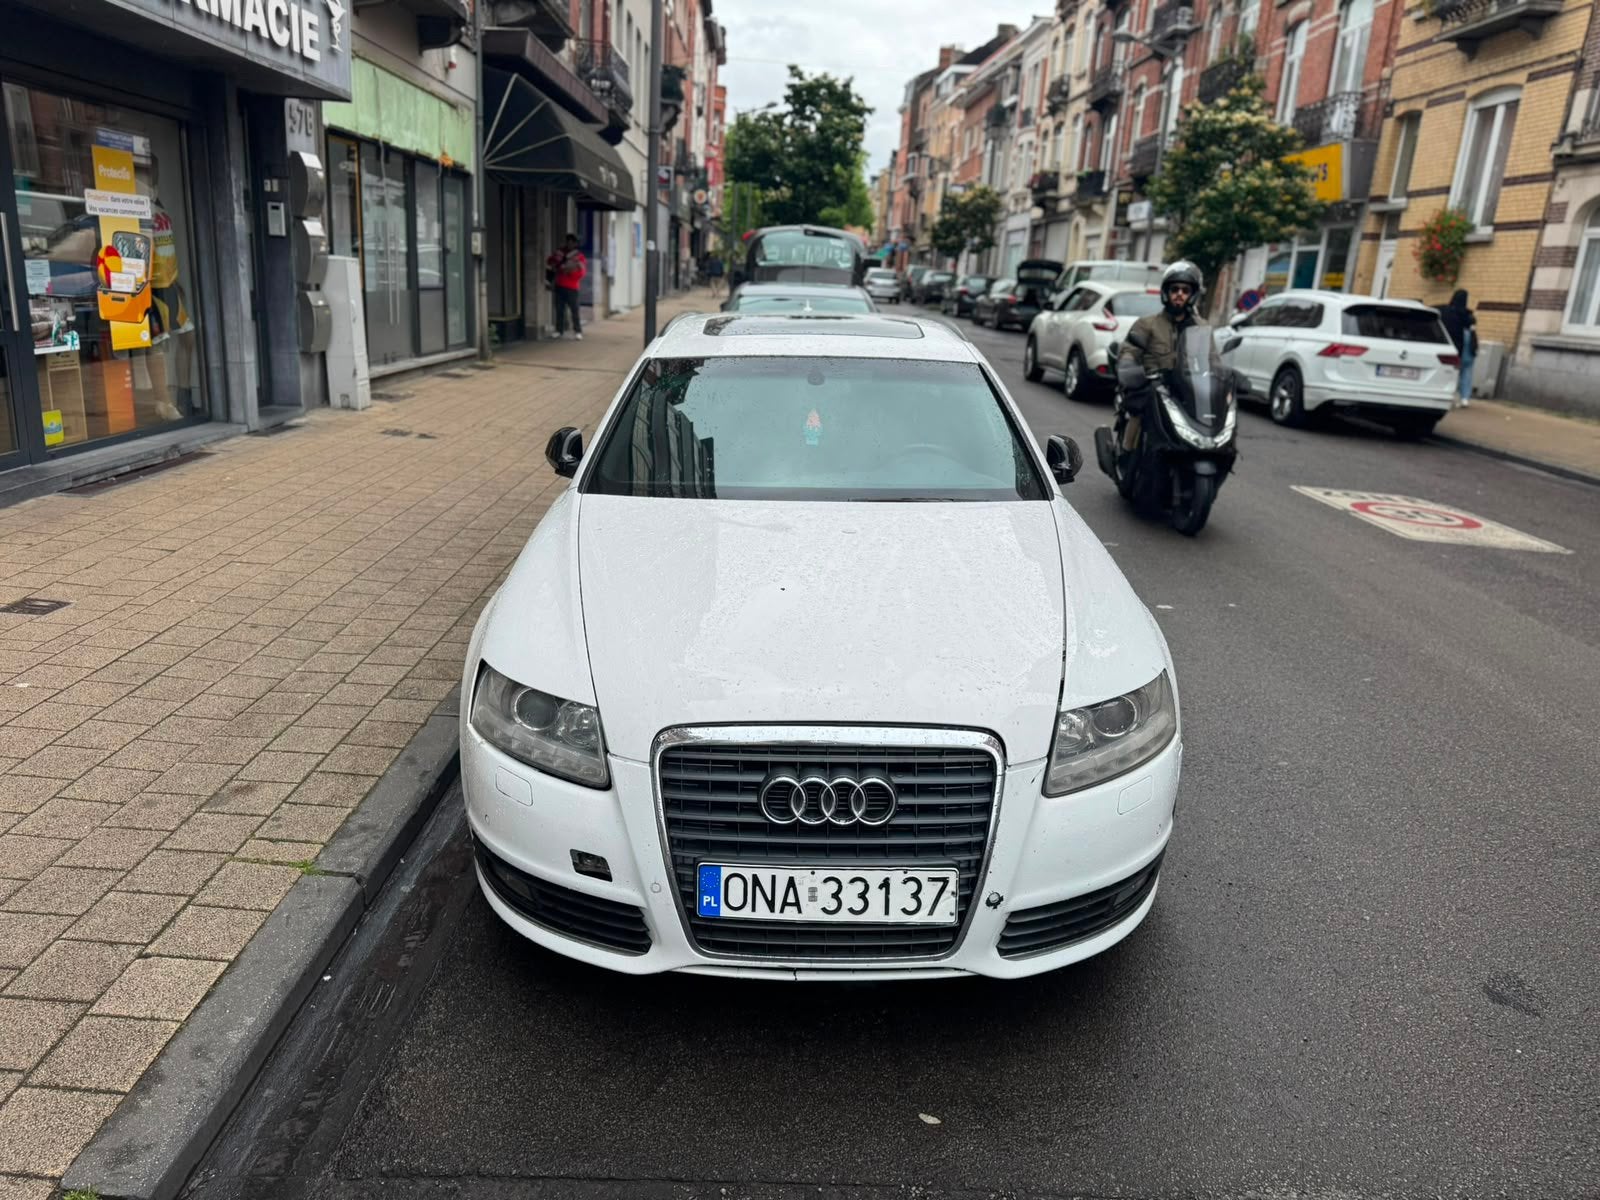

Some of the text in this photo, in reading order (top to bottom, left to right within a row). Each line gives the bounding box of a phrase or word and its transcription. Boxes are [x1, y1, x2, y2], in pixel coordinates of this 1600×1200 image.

[703, 872, 951, 916] PL ONA 33137
